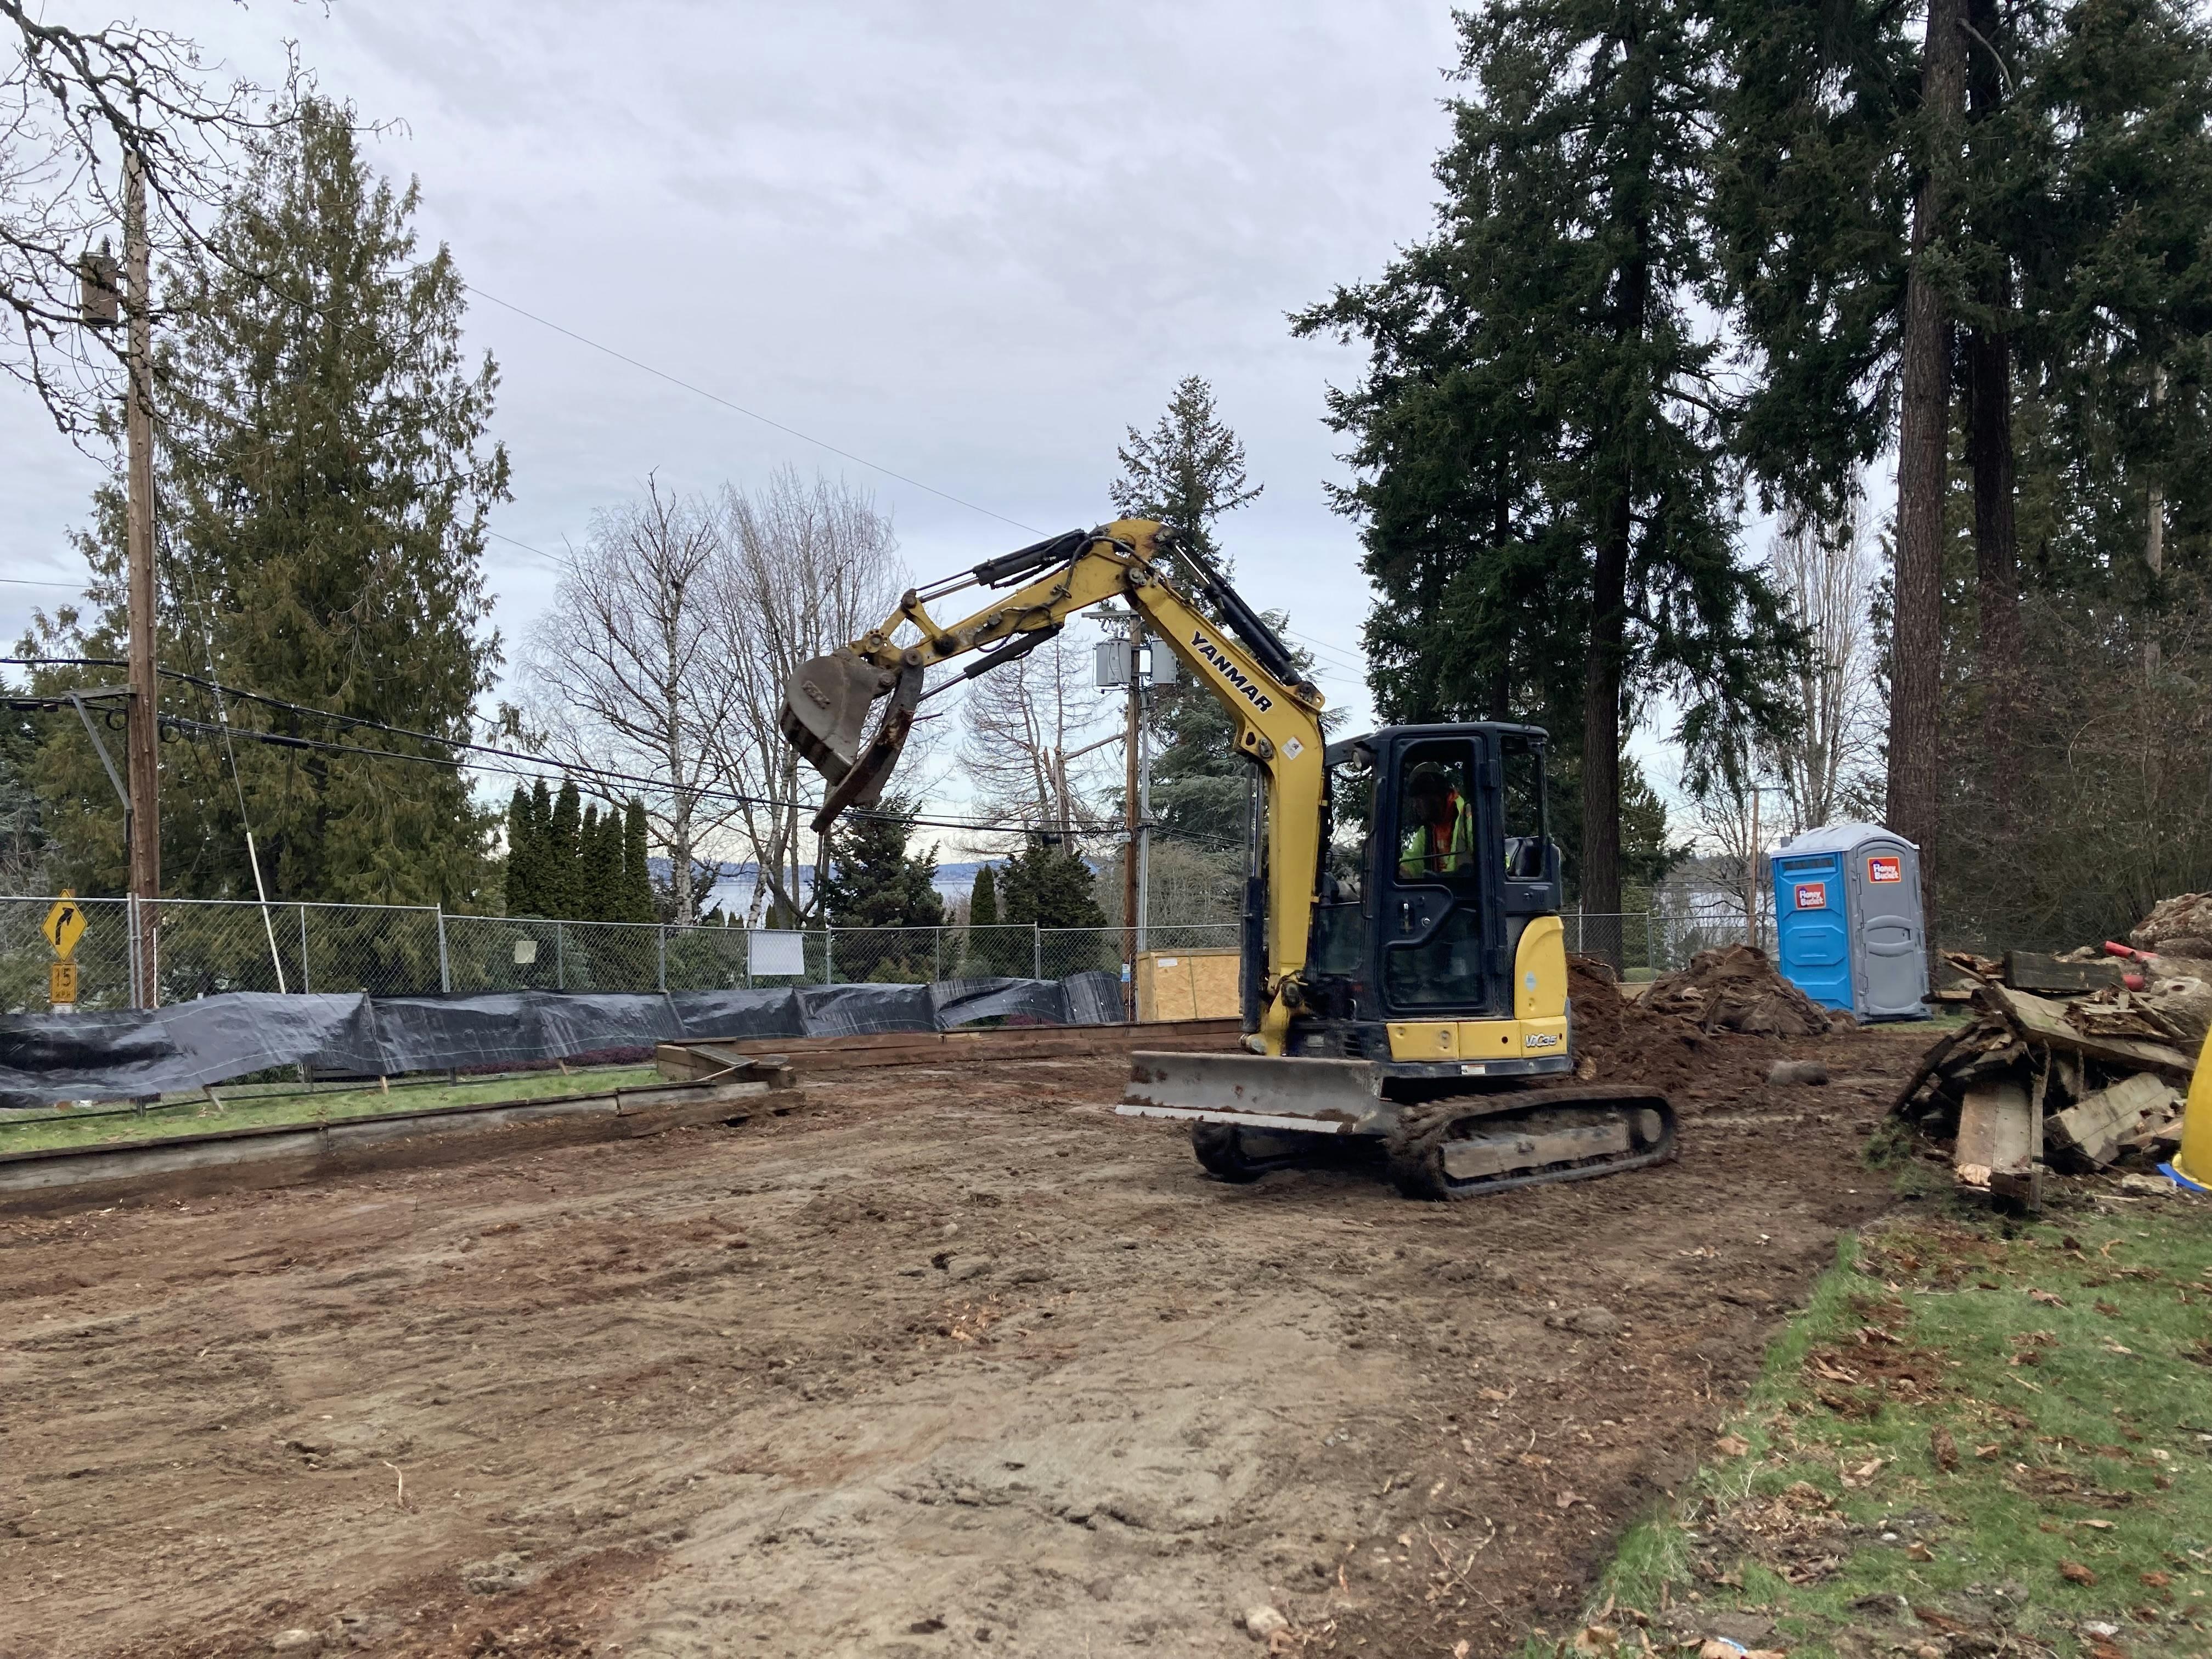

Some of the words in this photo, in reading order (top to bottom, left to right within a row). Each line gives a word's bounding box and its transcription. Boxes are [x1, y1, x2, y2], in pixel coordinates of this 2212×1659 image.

[1190, 630, 1273, 713] YANMAR
[1872, 864, 1897, 873] Honey
[1874, 871, 1899, 880] Bucket
[1799, 890, 1821, 899] Honey
[55, 968, 71, 988] 15
